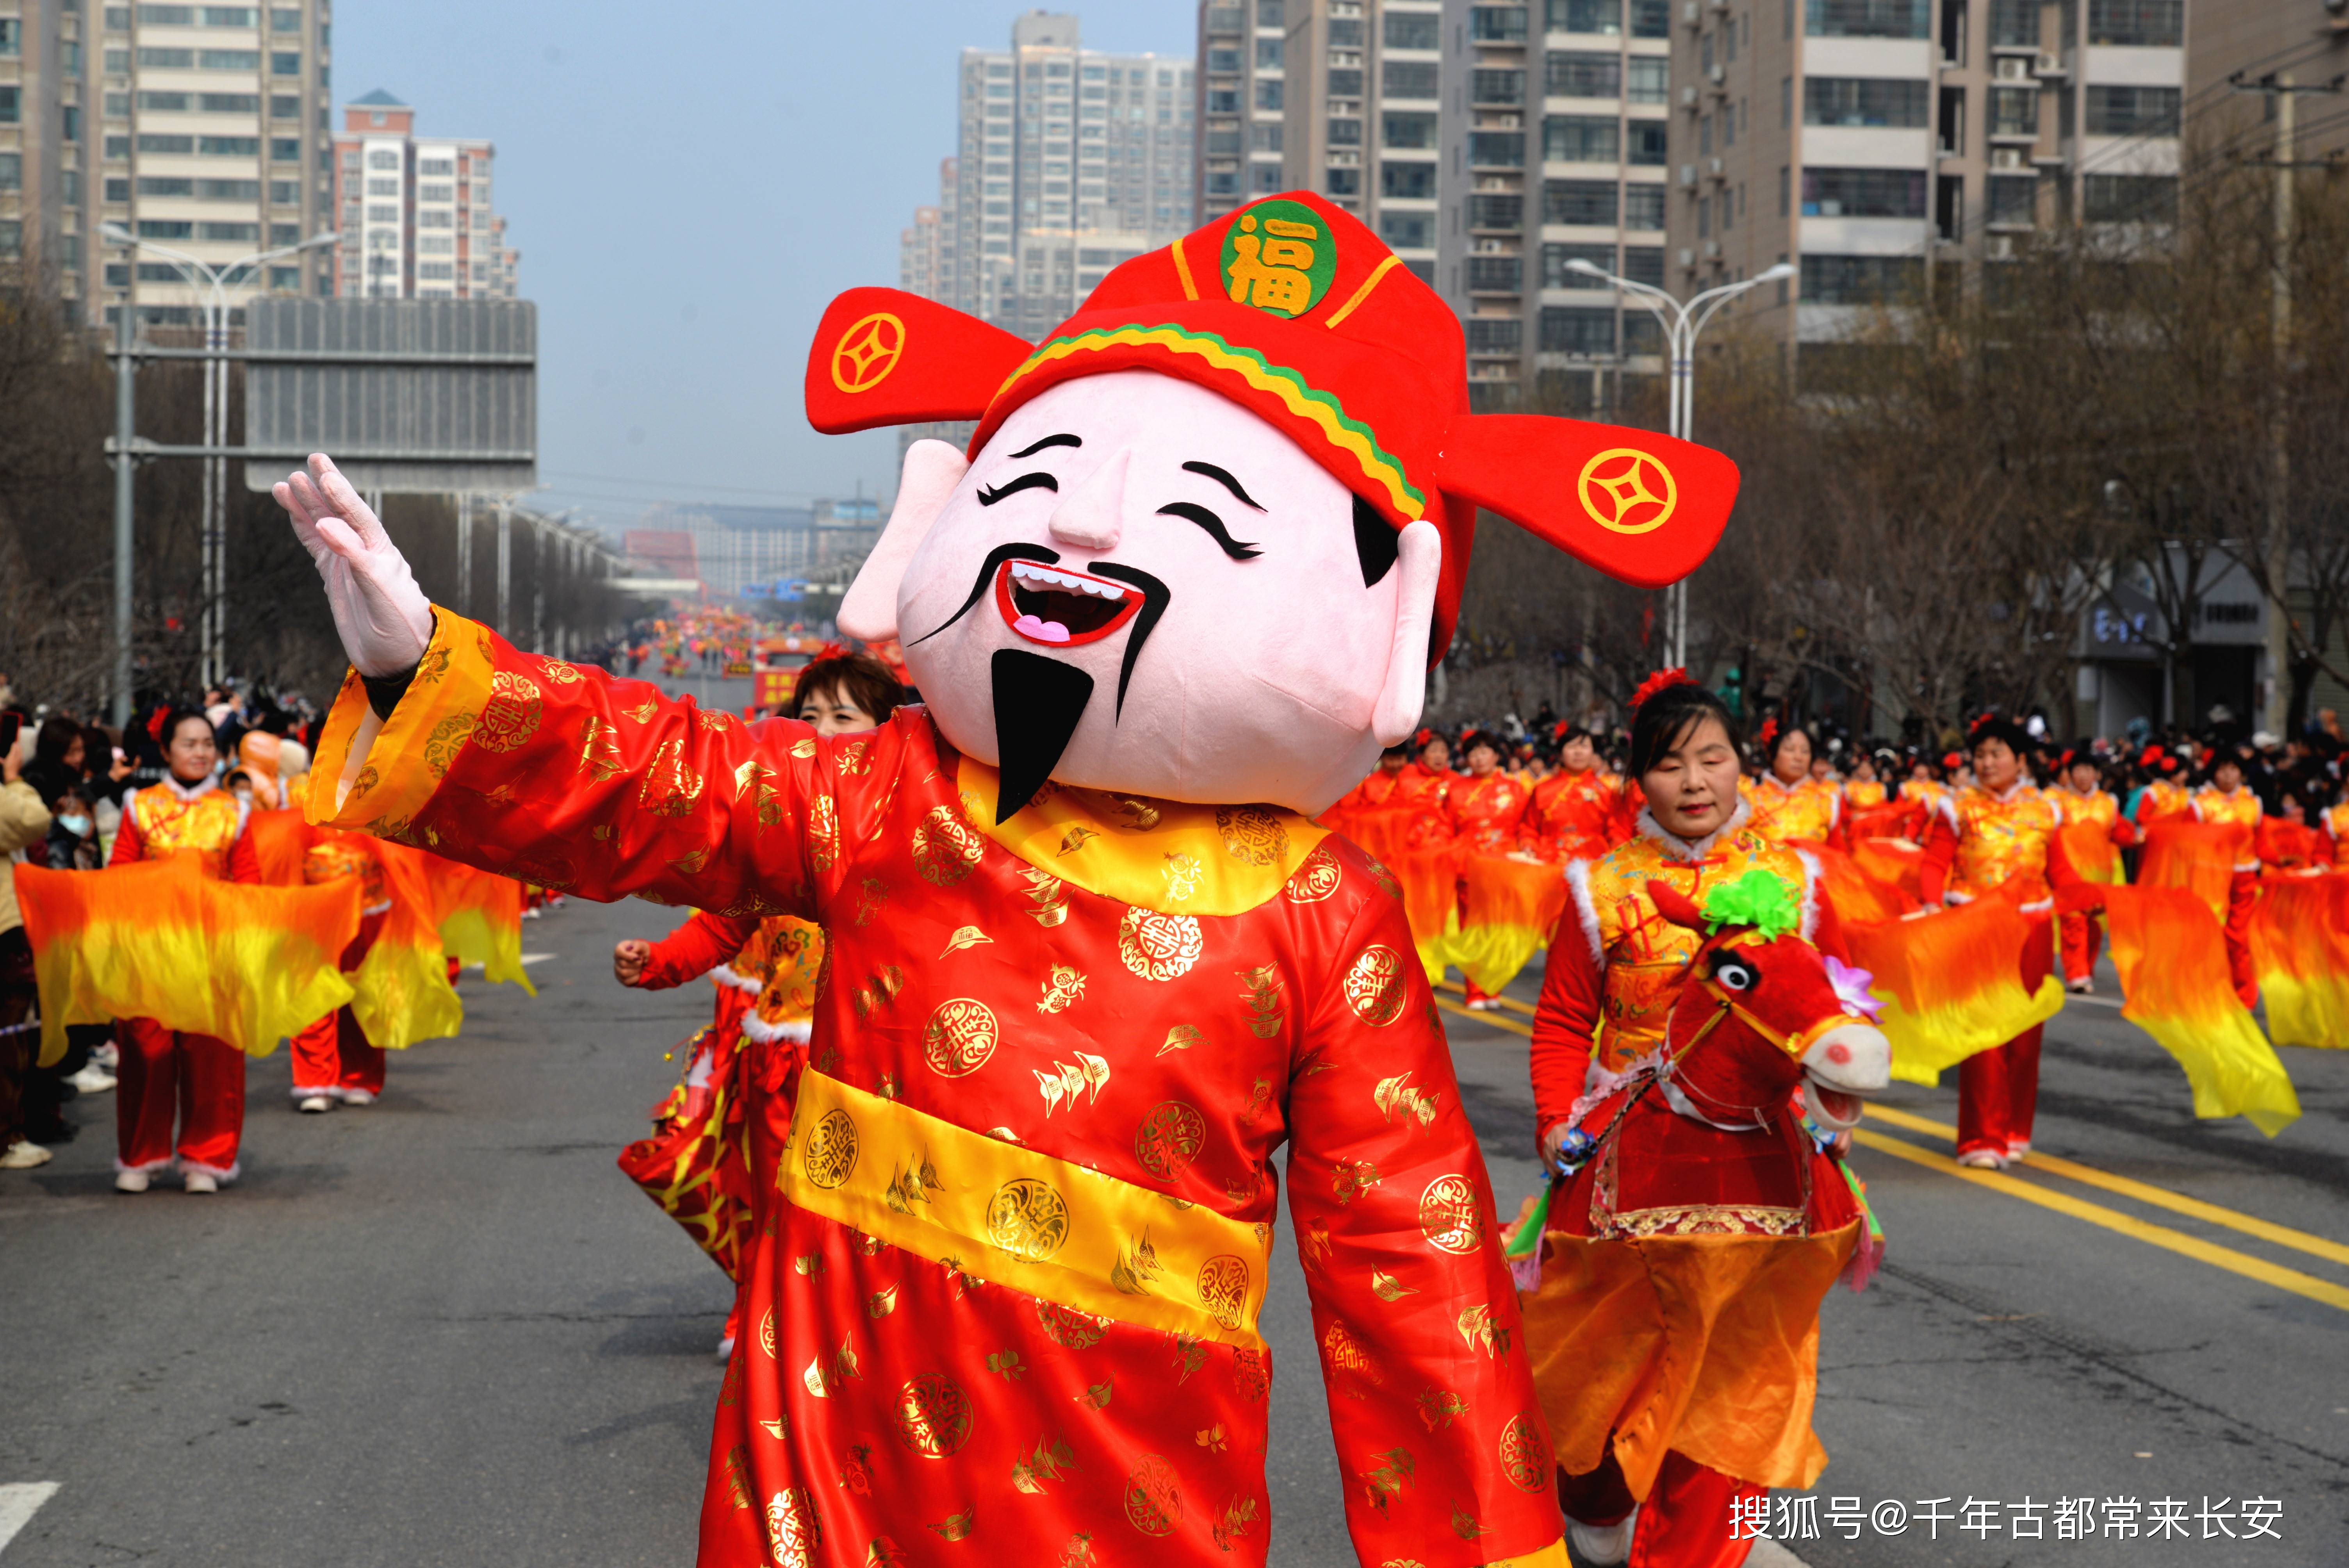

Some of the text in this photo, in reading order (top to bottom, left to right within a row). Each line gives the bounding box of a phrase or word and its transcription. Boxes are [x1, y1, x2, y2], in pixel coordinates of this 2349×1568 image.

[1228, 215, 1317, 315] 福
[640, 710, 652, 721] 福
[800, 745, 816, 755] 福
[688, 859, 702, 871] 福
[1040, 888, 1052, 901] 福
[1045, 912, 1059, 925] 福
[959, 928, 973, 940] 福
[1176, 1026, 1191, 1039] 福
[1259, 1024, 1272, 1036] 福
[1092, 1061, 1107, 1077] 福
[1069, 1071, 1082, 1086] 福
[1048, 1080, 1059, 1094] 福
[1376, 1086, 1391, 1101] 福
[1400, 1095, 1412, 1109] 福
[1419, 1104, 1429, 1117] 福
[1377, 1282, 1393, 1297] 福
[1460, 1313, 1475, 1329] 福
[807, 1374, 822, 1390] 福
[1016, 1472, 1029, 1489] 福
